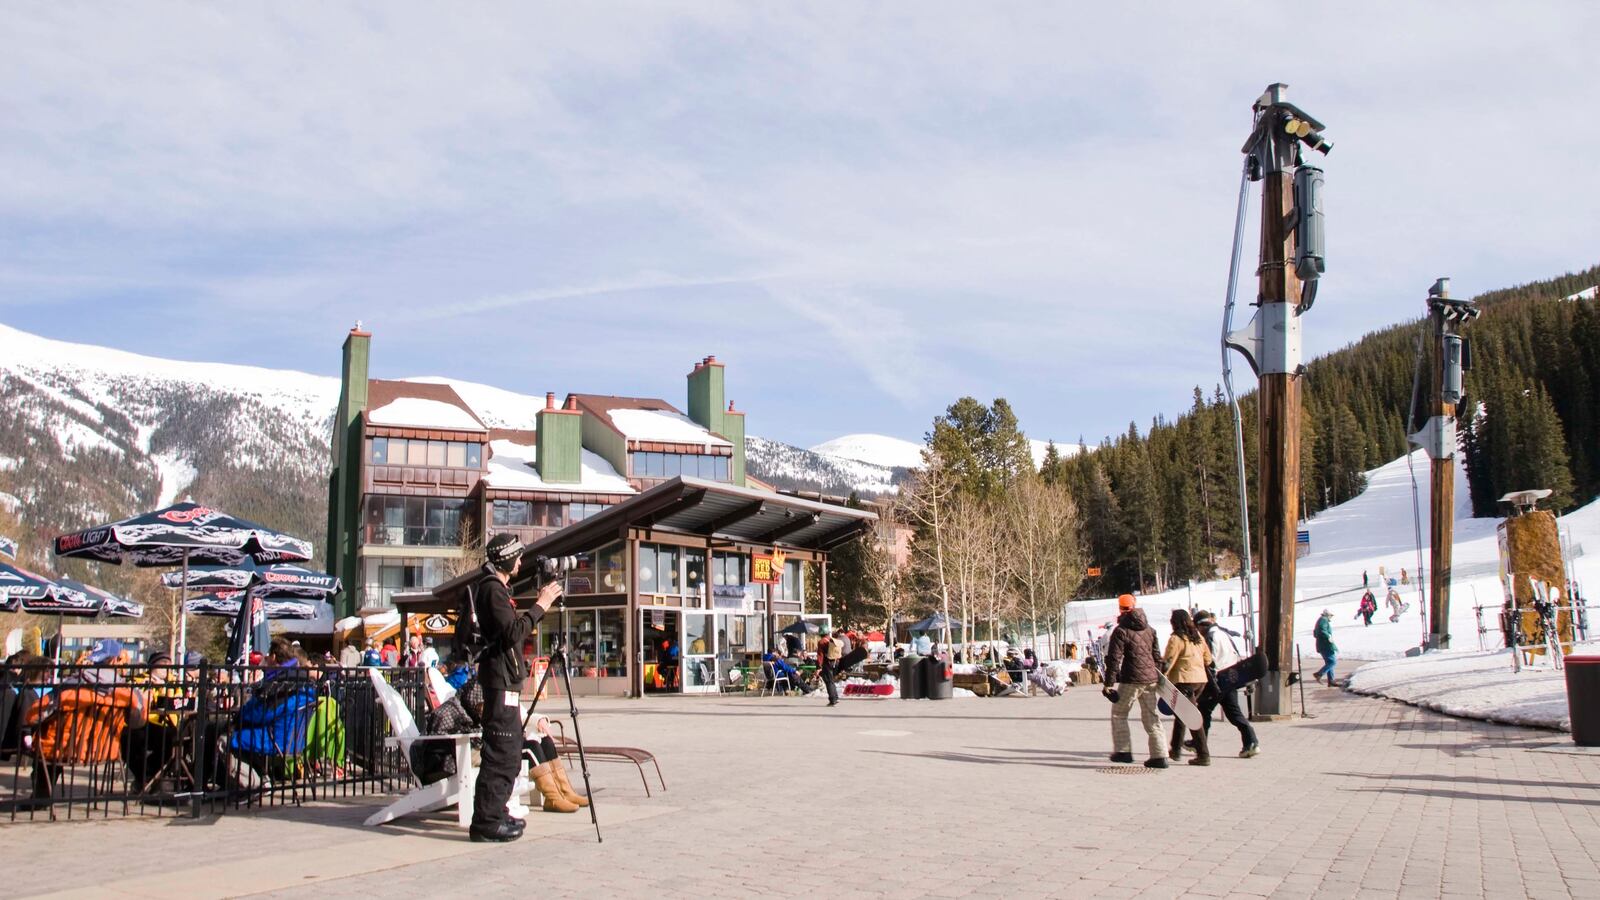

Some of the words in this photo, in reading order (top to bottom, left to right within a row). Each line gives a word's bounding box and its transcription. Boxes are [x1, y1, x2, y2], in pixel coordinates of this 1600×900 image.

[82, 530, 106, 545] LIGHT
[755, 563, 770, 573] RED
[300, 575, 332, 586] LIGHT
[755, 571, 770, 580] HOTS
